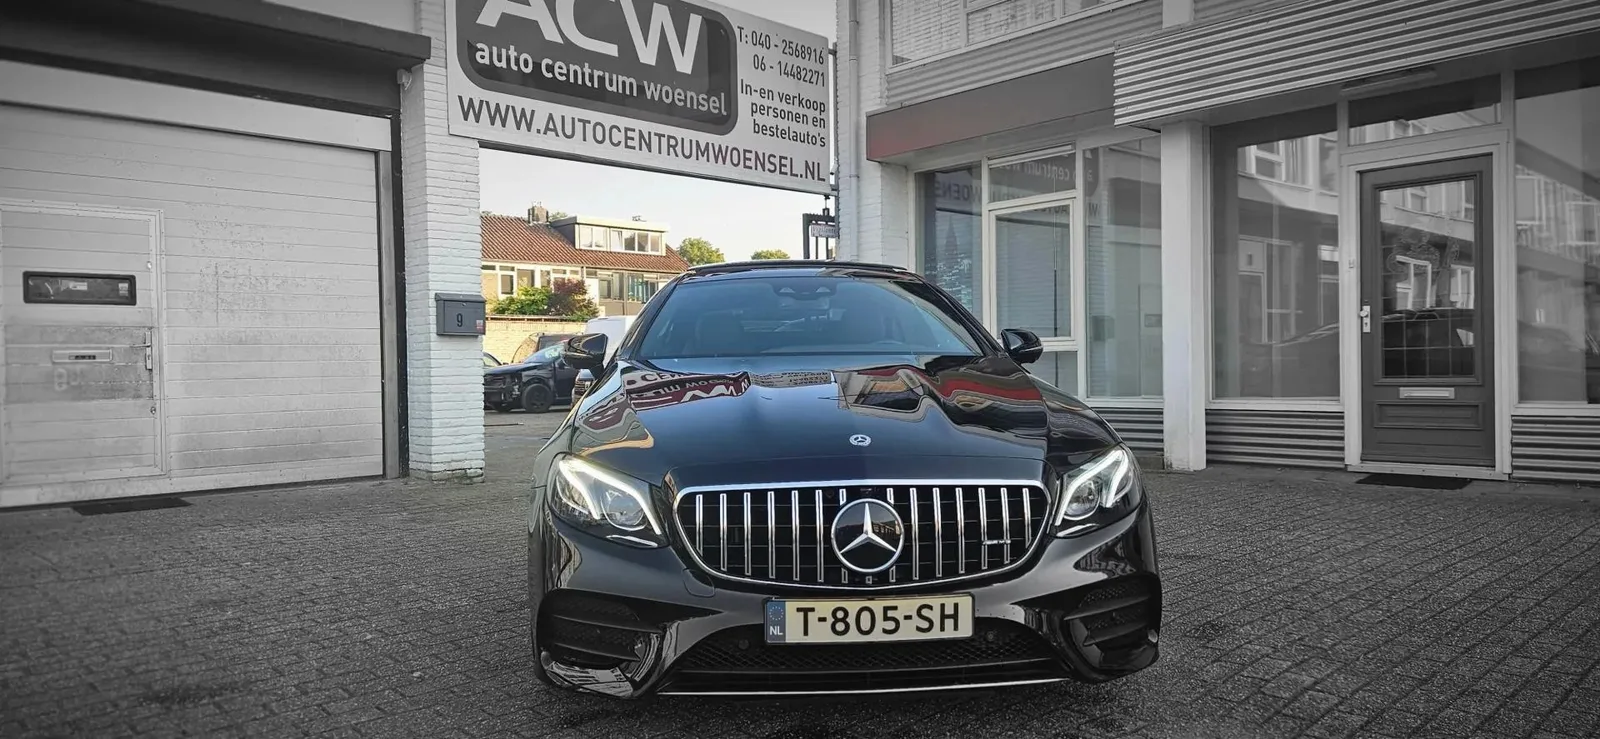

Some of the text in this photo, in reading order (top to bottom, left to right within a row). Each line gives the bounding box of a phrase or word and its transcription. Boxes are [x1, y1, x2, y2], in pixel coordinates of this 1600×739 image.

[751, 30, 771, 50] 040
[781, 39, 824, 65] 2568916
[475, 42, 727, 116] auto centrum woensel
[753, 54, 766, 72] 06
[777, 60, 825, 87] 14482271
[740, 78, 826, 115] In-en verkoop
[751, 102, 826, 129] personen en
[457, 94, 826, 183] WWW.AUTOCENTRUMWOENSEL.NL
[753, 119, 826, 148] bestelauto's
[456, 312, 463, 328] 9
[769, 602, 960, 637] NL T-805-SH
